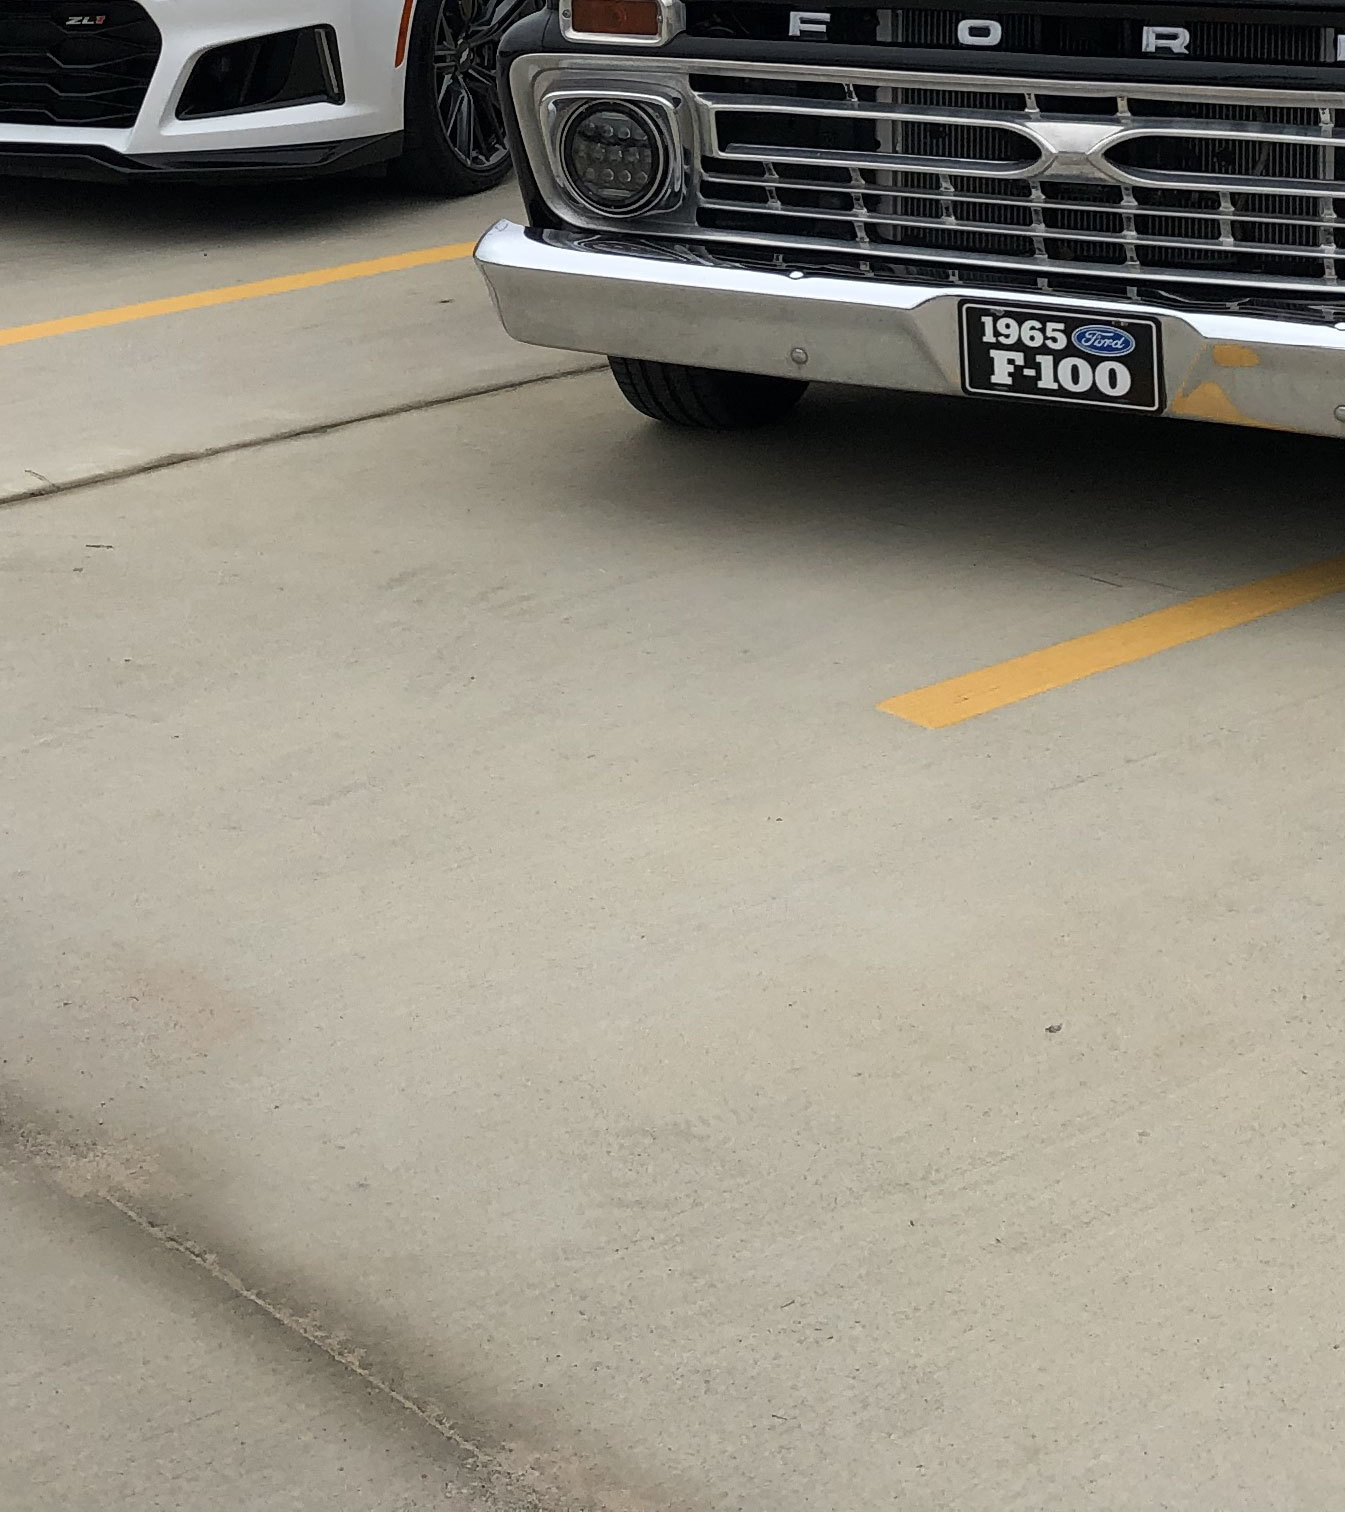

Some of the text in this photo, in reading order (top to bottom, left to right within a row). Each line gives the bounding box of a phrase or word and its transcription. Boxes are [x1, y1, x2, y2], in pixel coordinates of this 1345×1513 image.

[66, 15, 106, 25] ZL1
[980, 315, 1126, 350] 1965 Ford
[989, 348, 1132, 397] F-100
